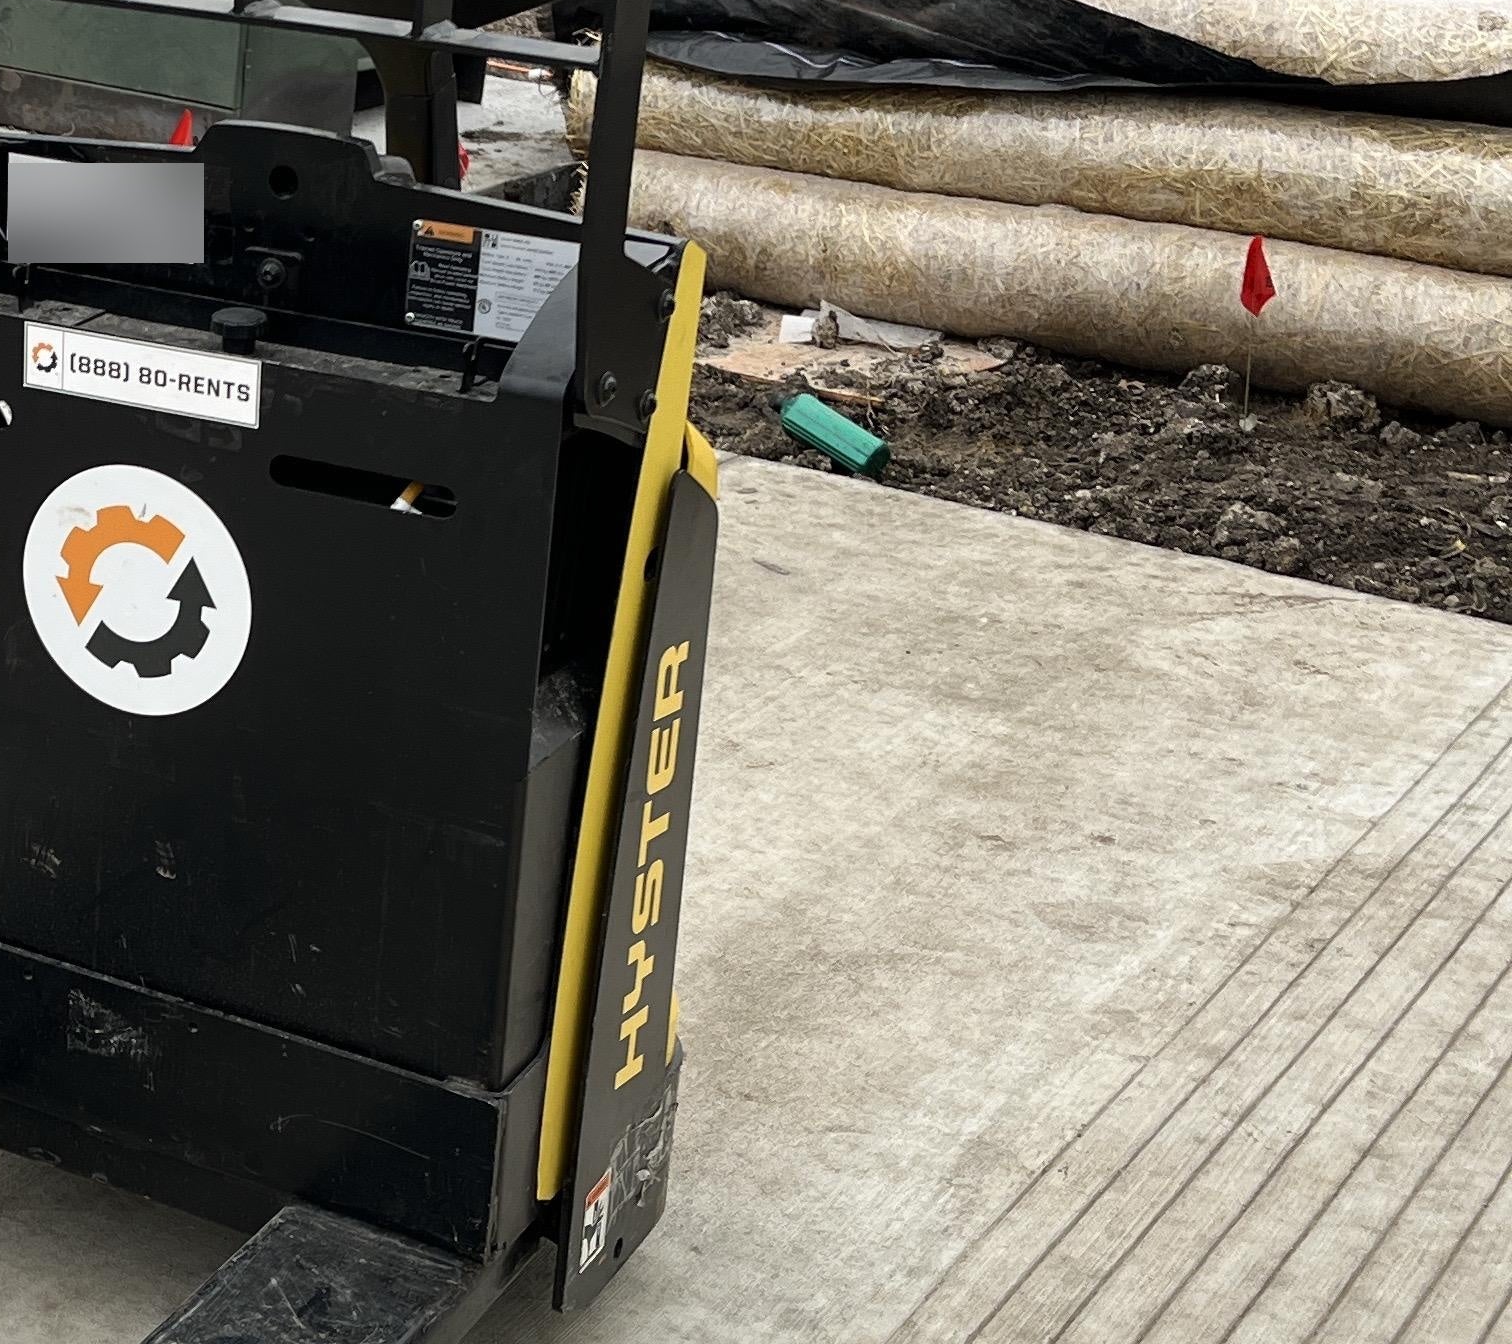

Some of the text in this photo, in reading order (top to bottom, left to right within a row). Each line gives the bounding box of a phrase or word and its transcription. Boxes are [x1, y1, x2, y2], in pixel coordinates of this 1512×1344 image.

[69, 352, 251, 402] (888) 80-RENTS
[614, 640, 690, 1090] HYSTER
